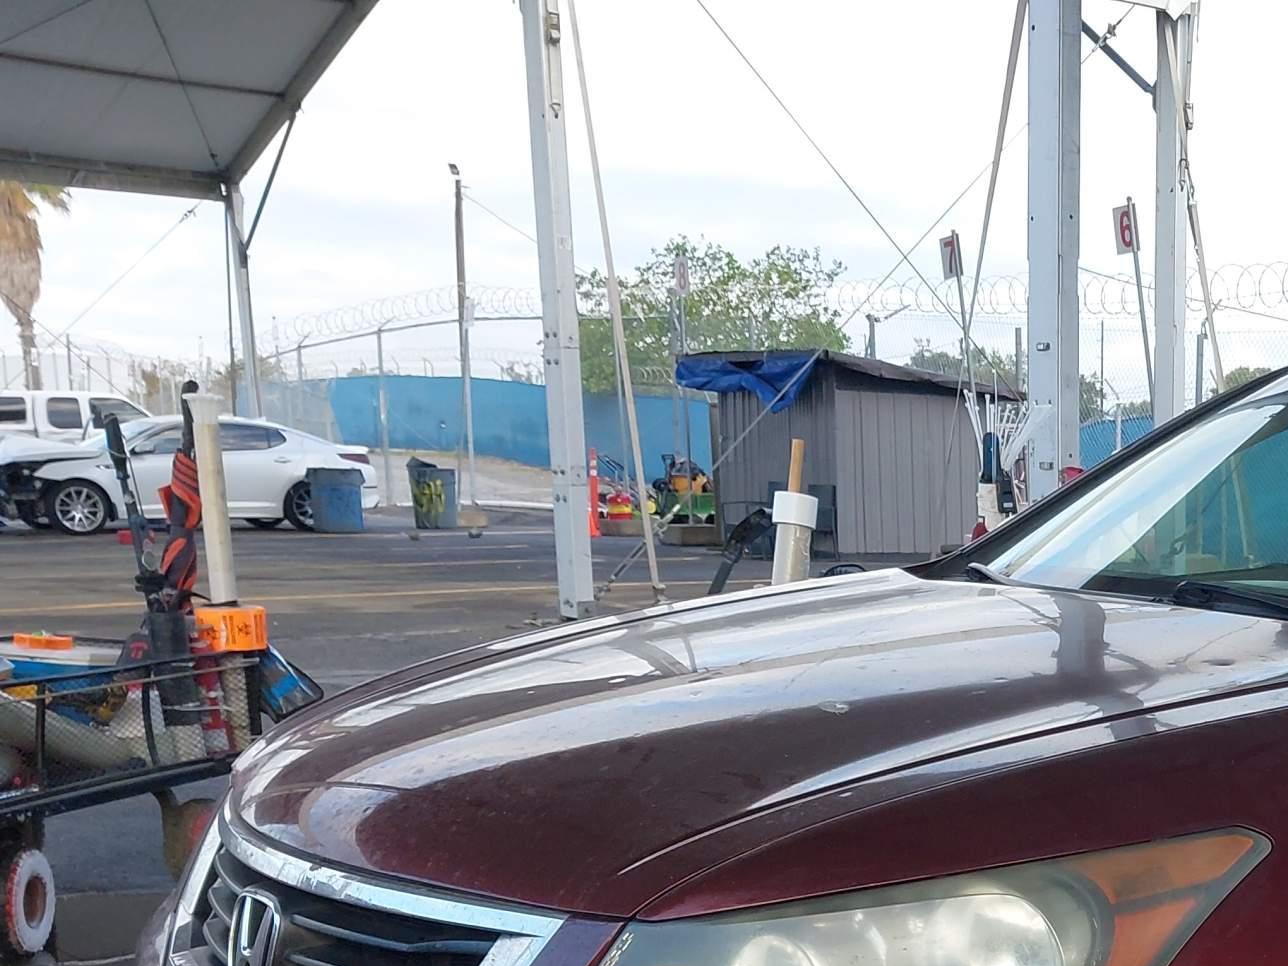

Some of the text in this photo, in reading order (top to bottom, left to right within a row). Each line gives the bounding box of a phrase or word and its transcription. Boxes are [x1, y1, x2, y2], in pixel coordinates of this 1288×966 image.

[1120, 210, 1132, 248] 6
[943, 239, 955, 274] 7
[678, 262, 687, 290] 8
